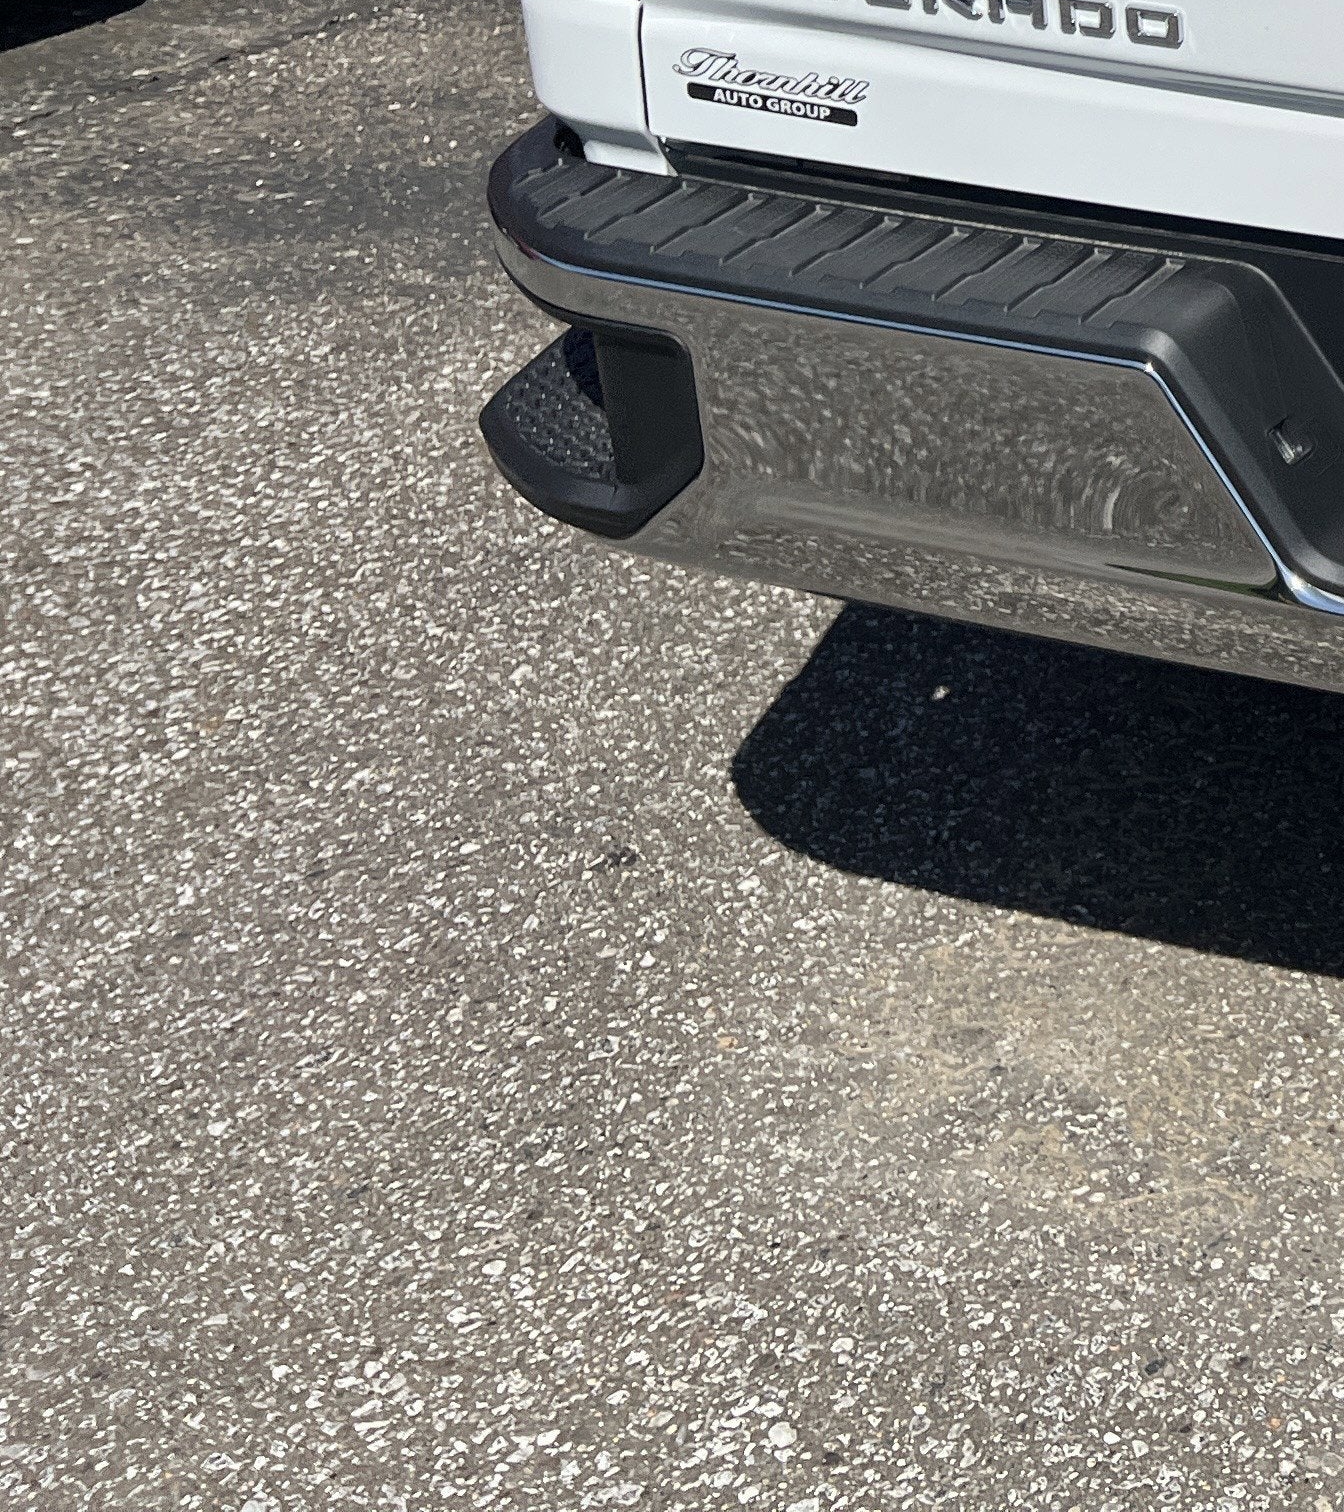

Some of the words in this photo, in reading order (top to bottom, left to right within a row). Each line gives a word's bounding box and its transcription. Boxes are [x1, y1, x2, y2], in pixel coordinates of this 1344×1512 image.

[672, 47, 870, 105] Thornhill
[712, 88, 763, 109] AUTO
[766, 99, 831, 120] GROUP
